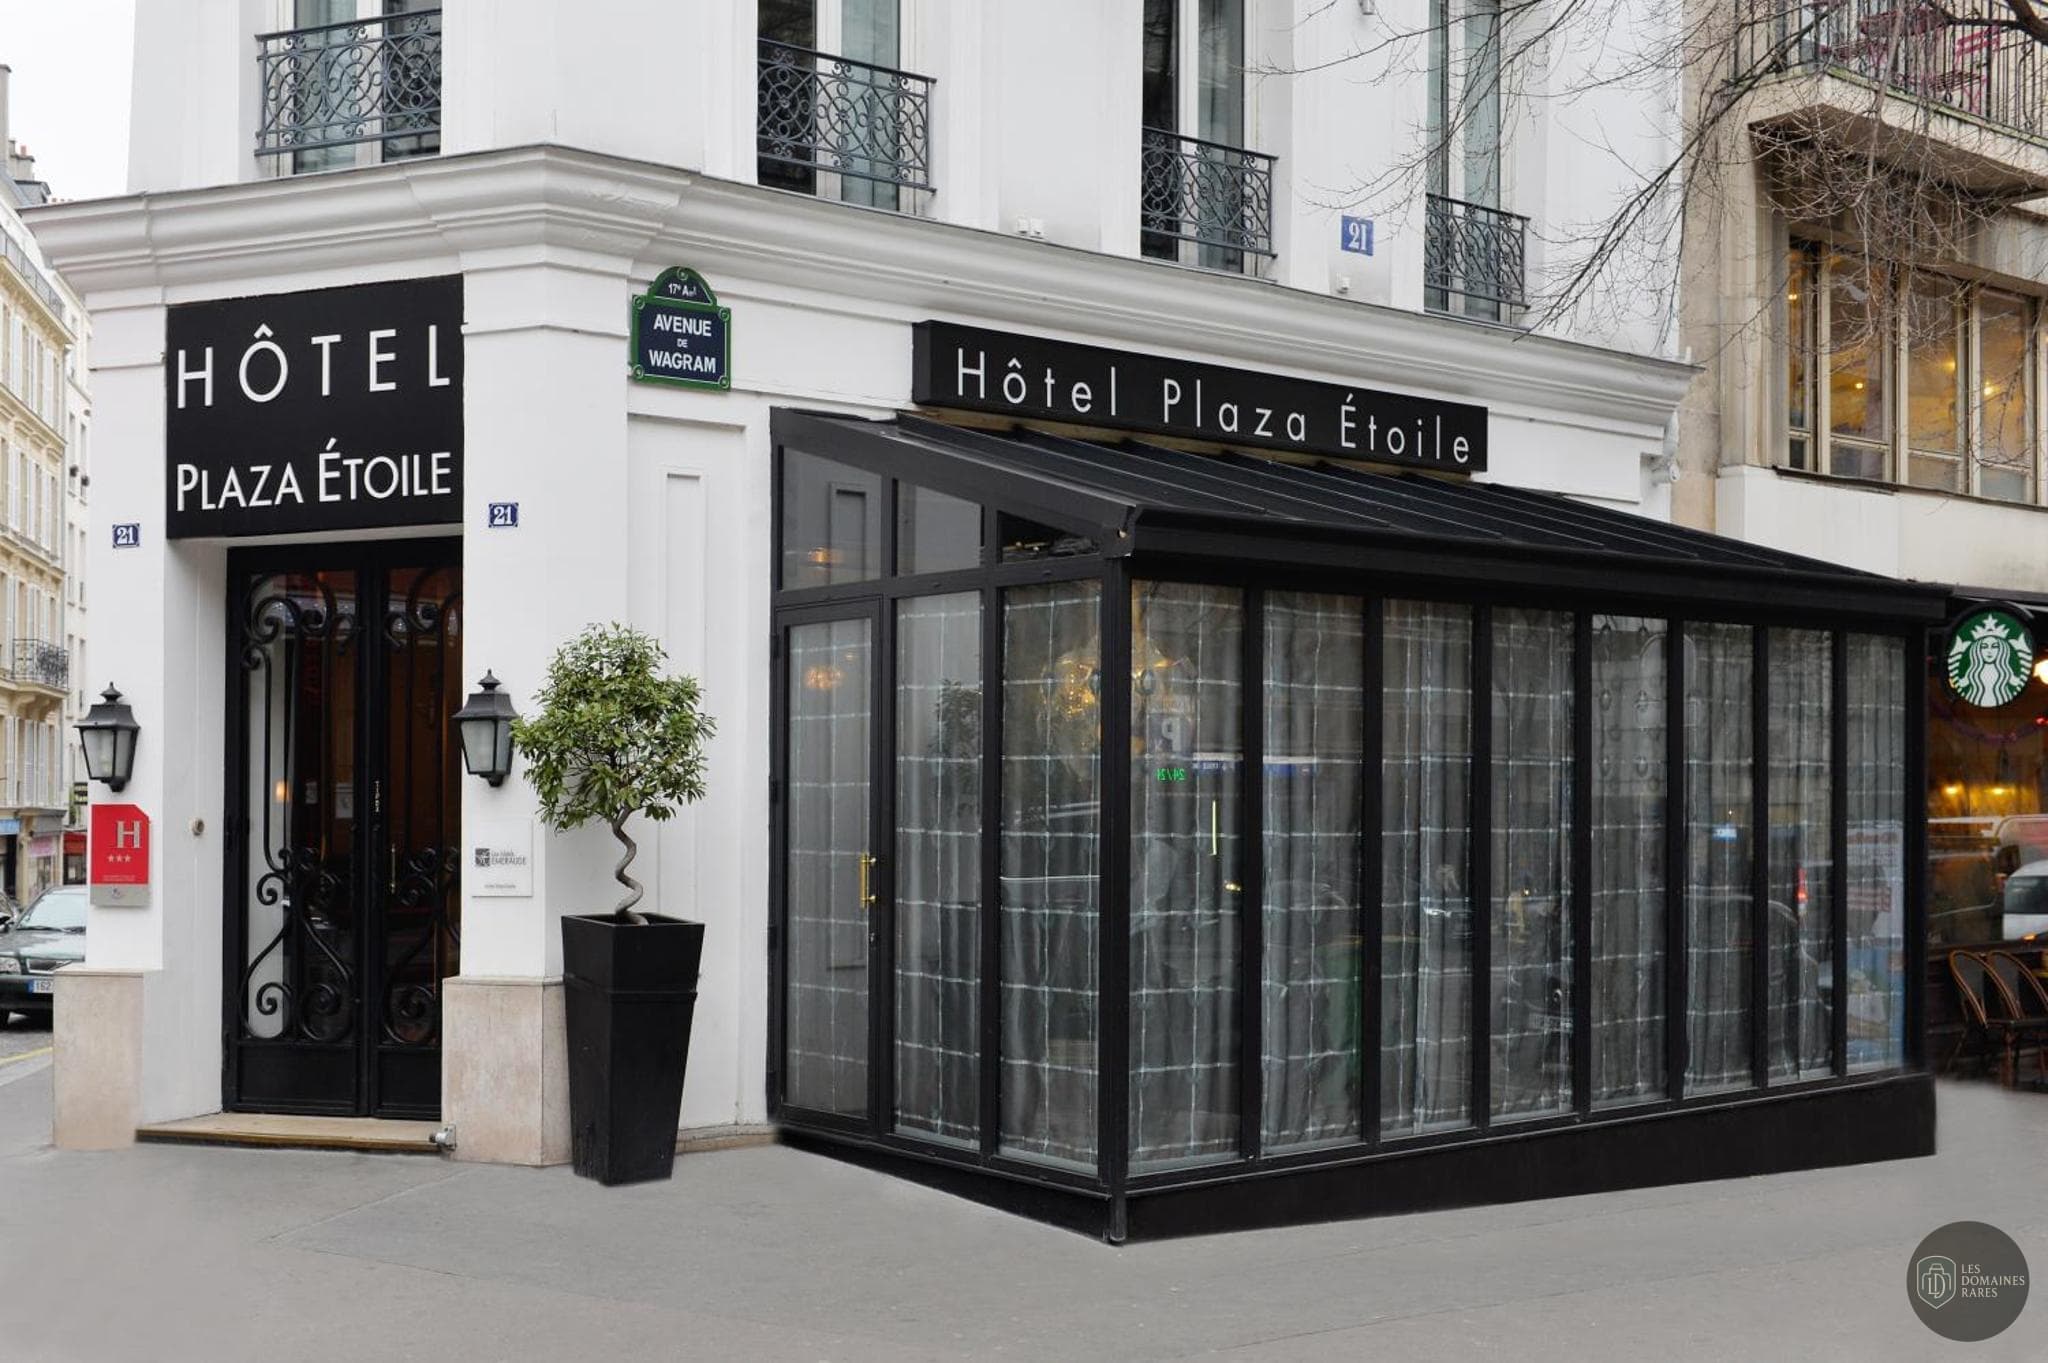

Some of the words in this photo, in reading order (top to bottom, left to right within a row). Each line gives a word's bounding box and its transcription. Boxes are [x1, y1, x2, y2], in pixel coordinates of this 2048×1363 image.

[1348, 222, 1367, 251] 21
[653, 314, 712, 337] AVENUE
[676, 338, 688, 348] DE
[177, 323, 450, 409] HÔTEL
[648, 349, 716, 374] WAGRAM
[957, 347, 1117, 416] Hôtel
[1163, 378, 1306, 442] Plaza
[1341, 393, 1469, 463] Étoile
[176, 462, 304, 512] PLAZA
[318, 437, 451, 502] ÉTOILE
[493, 505, 513, 525] 21
[116, 526, 135, 545] 21
[116, 820, 141, 849] H
